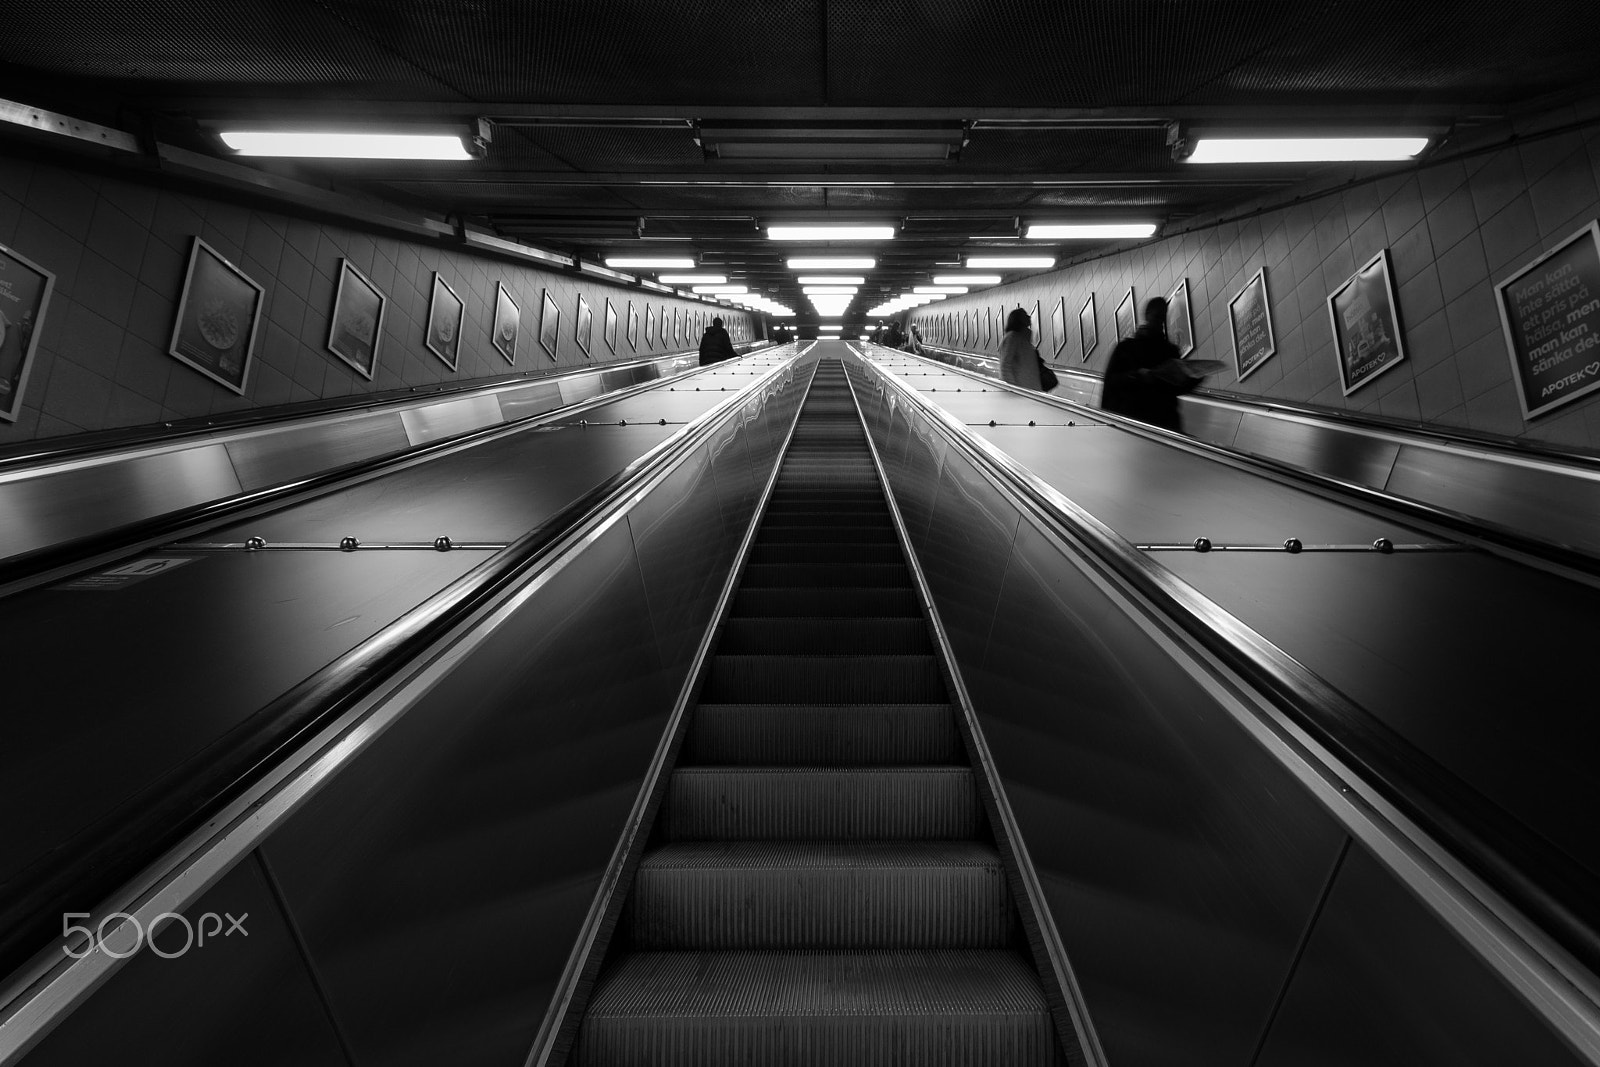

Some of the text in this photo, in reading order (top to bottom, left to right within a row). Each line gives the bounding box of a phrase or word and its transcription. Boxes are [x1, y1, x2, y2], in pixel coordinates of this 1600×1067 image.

[1515, 263, 1572, 304] Man kan
[1518, 275, 1580, 318] inte sätta
[1522, 283, 1589, 332] ett pris på
[1524, 299, 1600, 347] hälsa, men
[1528, 322, 1588, 361] man kan
[1532, 347, 1573, 376] sänka
[1351, 358, 1377, 379] APOTEK
[1541, 369, 1586, 398] APOTEK
